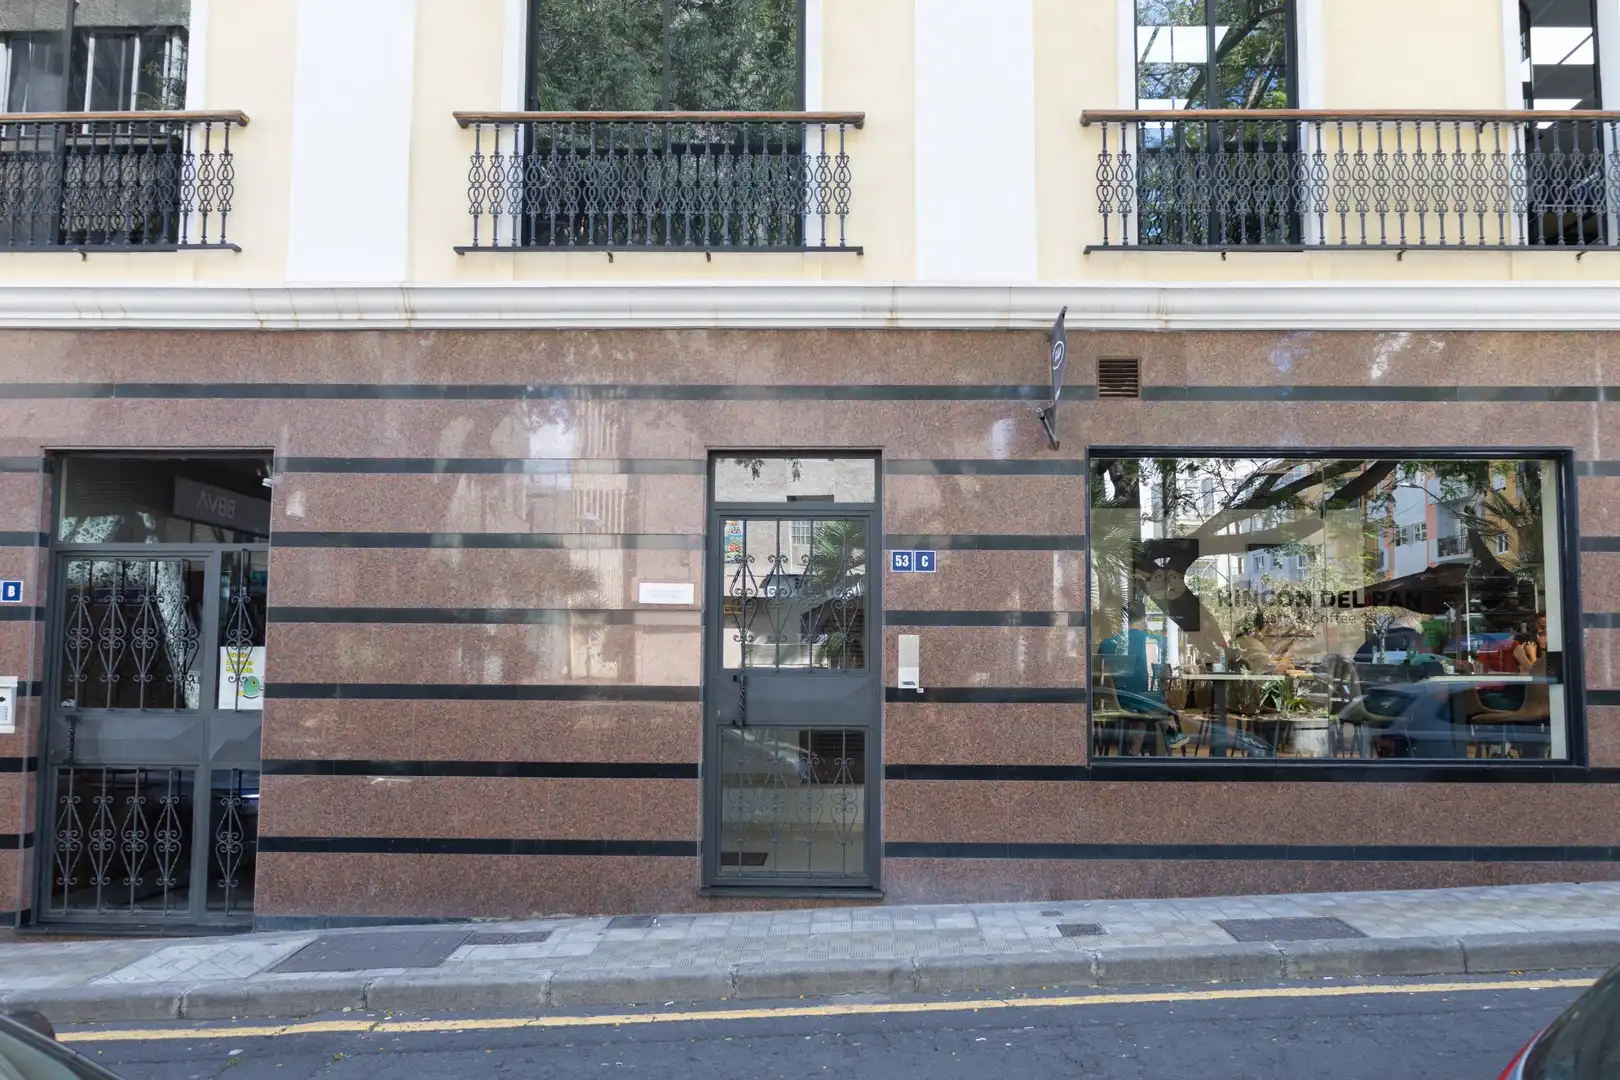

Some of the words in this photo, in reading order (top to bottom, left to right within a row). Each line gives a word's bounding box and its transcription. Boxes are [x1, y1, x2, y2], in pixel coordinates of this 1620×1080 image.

[895, 554, 909, 567] 53
[921, 555, 929, 567] C
[7, 585, 16, 598] B
[1320, 590, 1365, 608] DEL
[1371, 590, 1422, 609] PAN
[1311, 611, 1356, 624] Coffee
